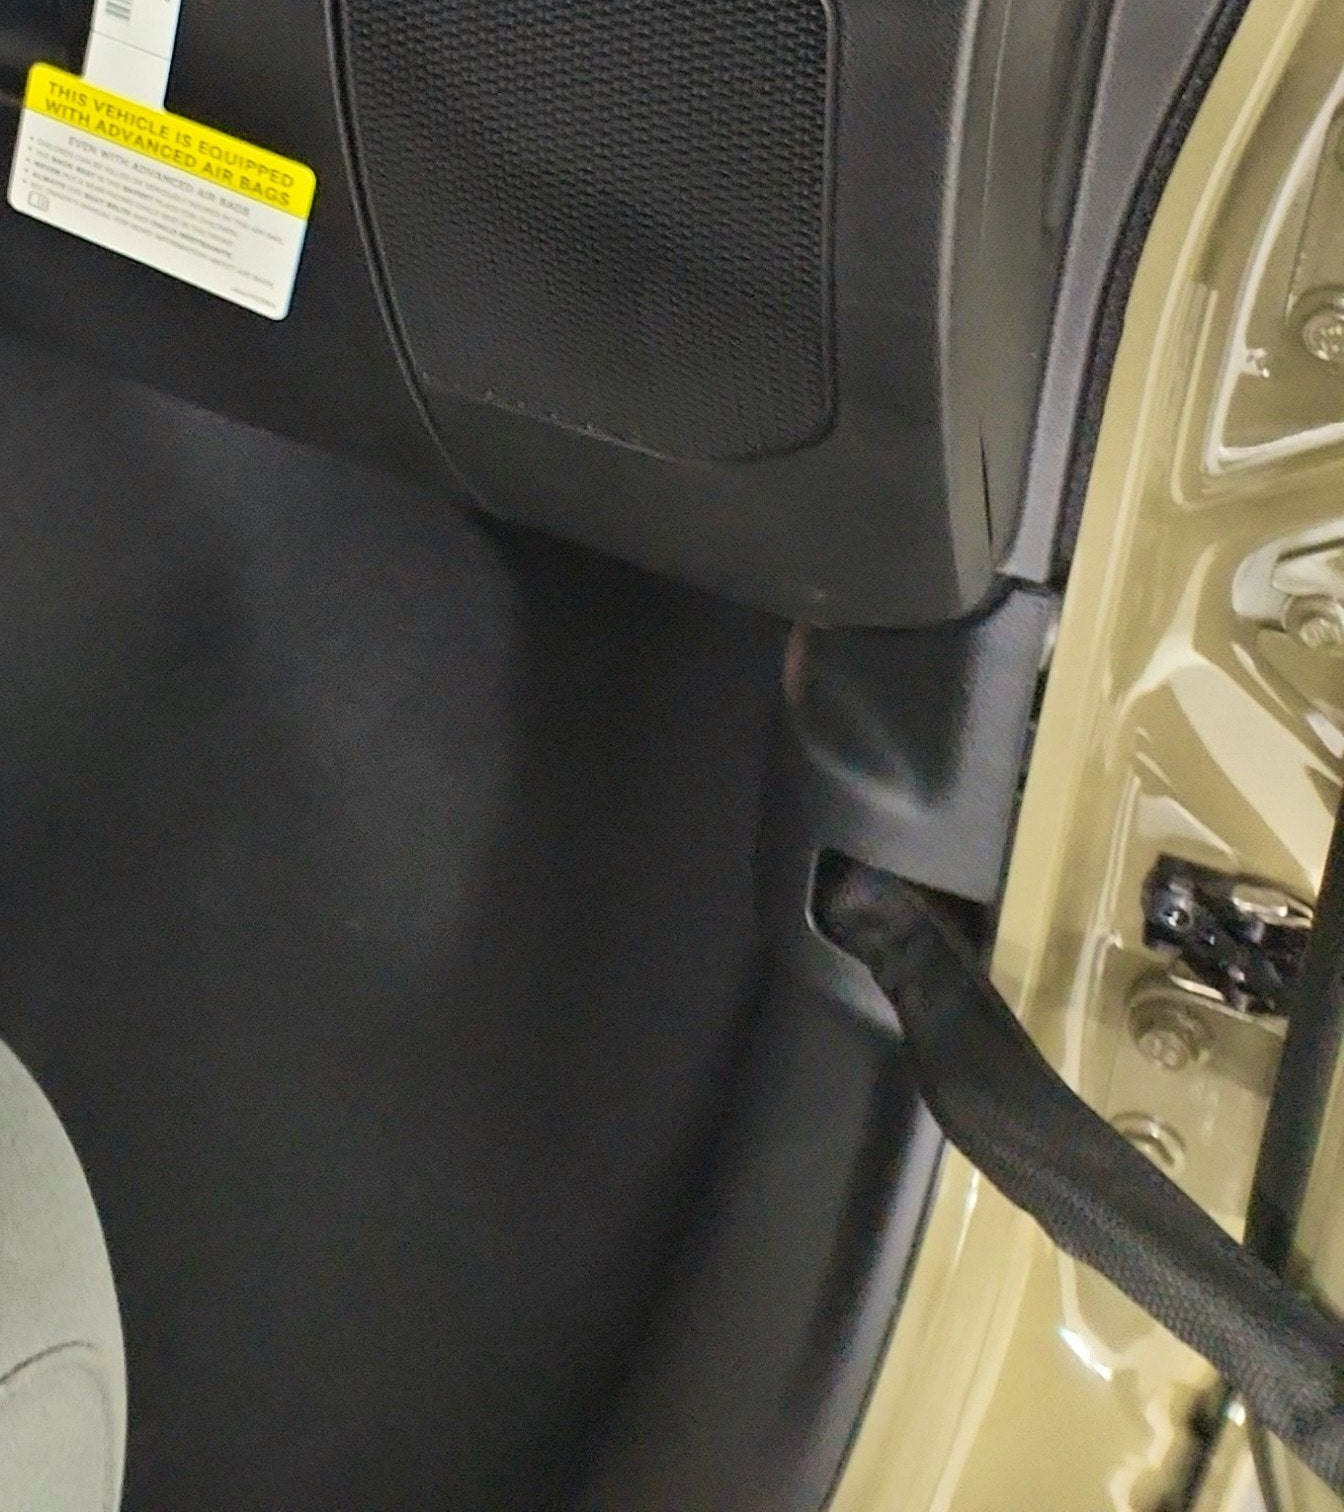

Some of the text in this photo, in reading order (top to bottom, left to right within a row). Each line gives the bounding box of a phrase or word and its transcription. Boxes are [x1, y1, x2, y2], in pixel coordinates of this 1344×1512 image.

[45, 97, 291, 207] WITH ADVANCED AIR BAGS
[49, 80, 295, 189] THIS VEHICLE IS EQUIPPED
[68, 135, 97, 155] EVEN
[99, 148, 129, 167] WITH
[132, 161, 194, 194] ADVANCED
